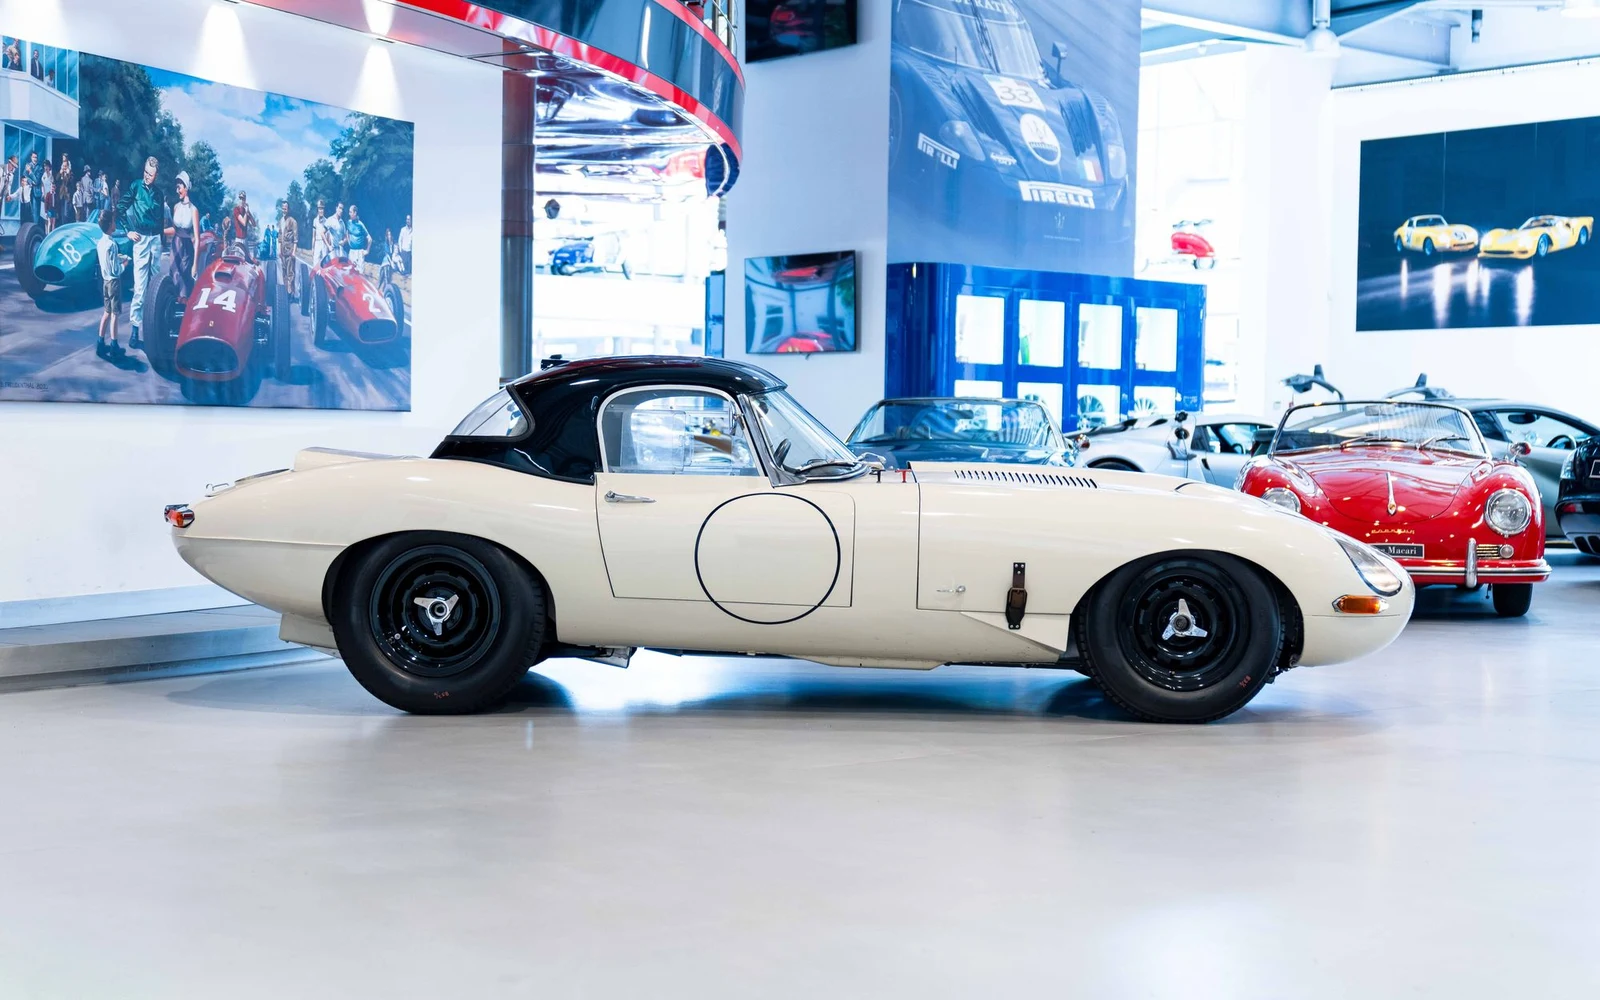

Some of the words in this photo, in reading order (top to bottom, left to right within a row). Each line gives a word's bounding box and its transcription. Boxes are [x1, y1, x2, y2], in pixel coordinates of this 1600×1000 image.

[999, 85, 1033, 104] 33
[917, 132, 960, 170] PIRLLI
[1018, 180, 1095, 209] PIRELLI
[58, 242, 82, 265] 18
[192, 287, 237, 313] 14
[1388, 546, 1417, 555] Macari
